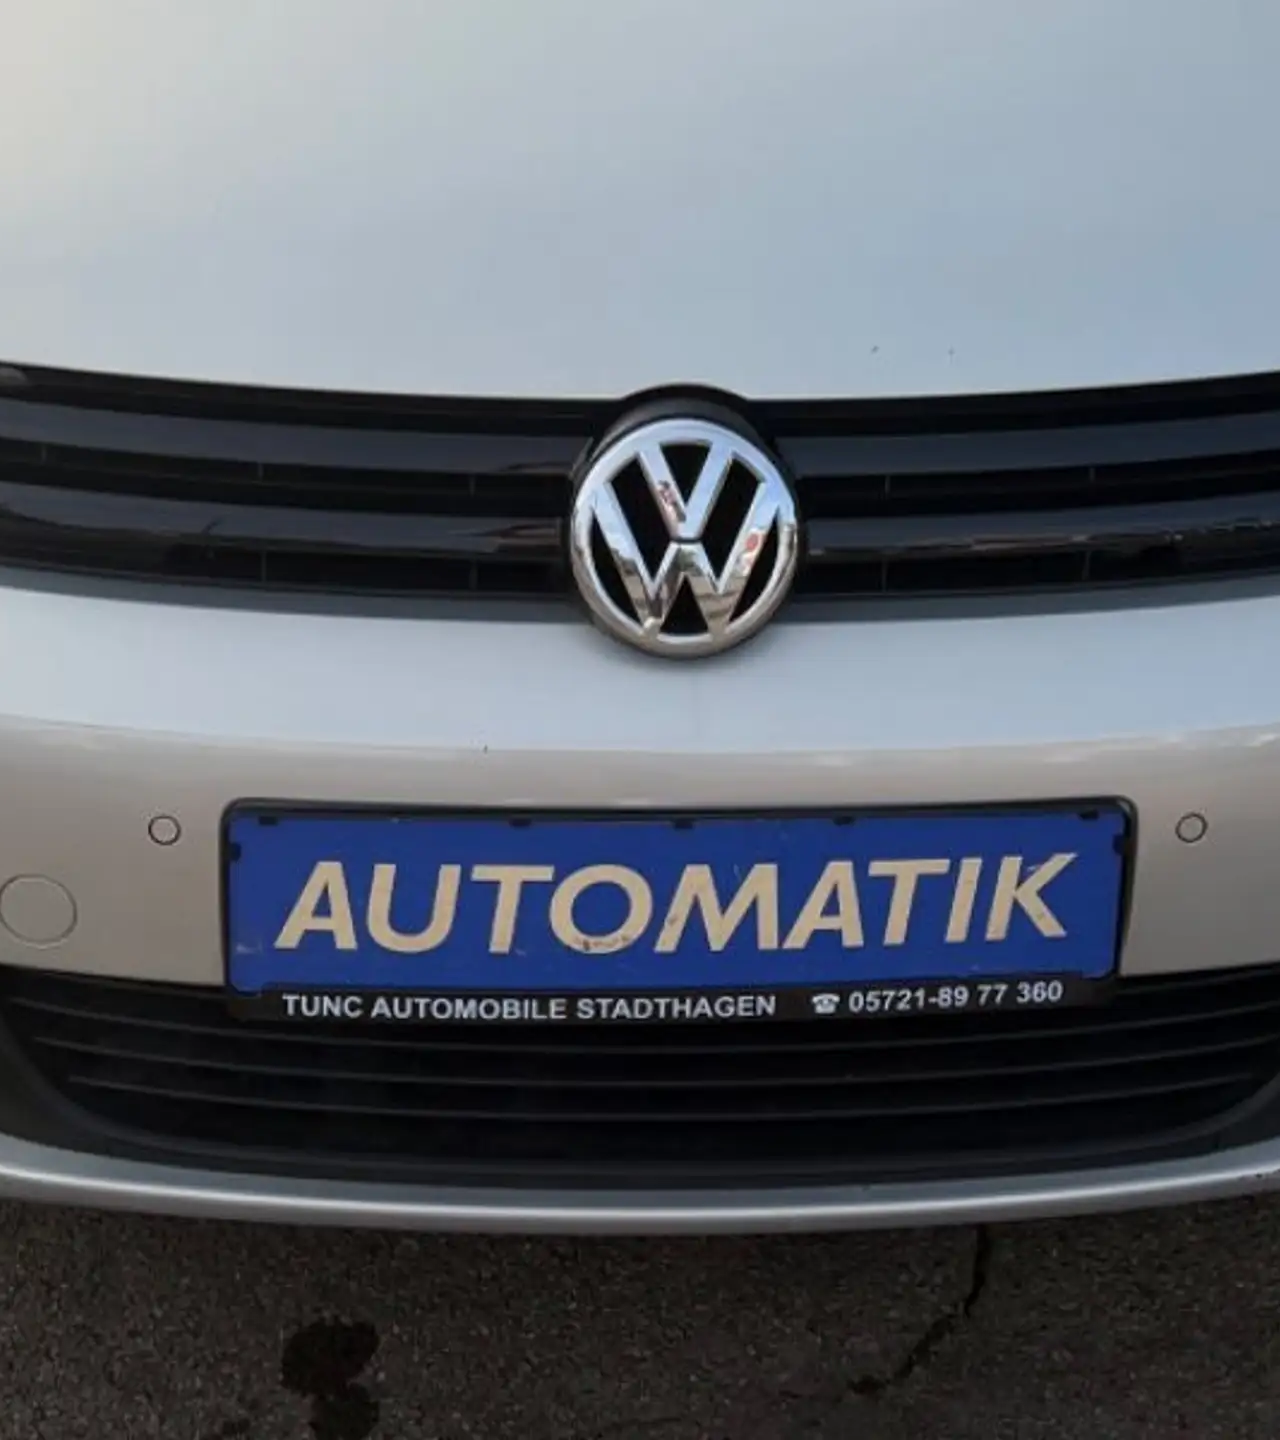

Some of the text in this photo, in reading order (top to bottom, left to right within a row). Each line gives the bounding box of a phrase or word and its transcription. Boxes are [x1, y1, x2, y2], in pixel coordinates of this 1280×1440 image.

[275, 852, 1079, 954] AUTOMATIK
[282, 980, 1064, 1020] TUNC AUTOMOBILE STADTHAGEN 05721-89 77 360
